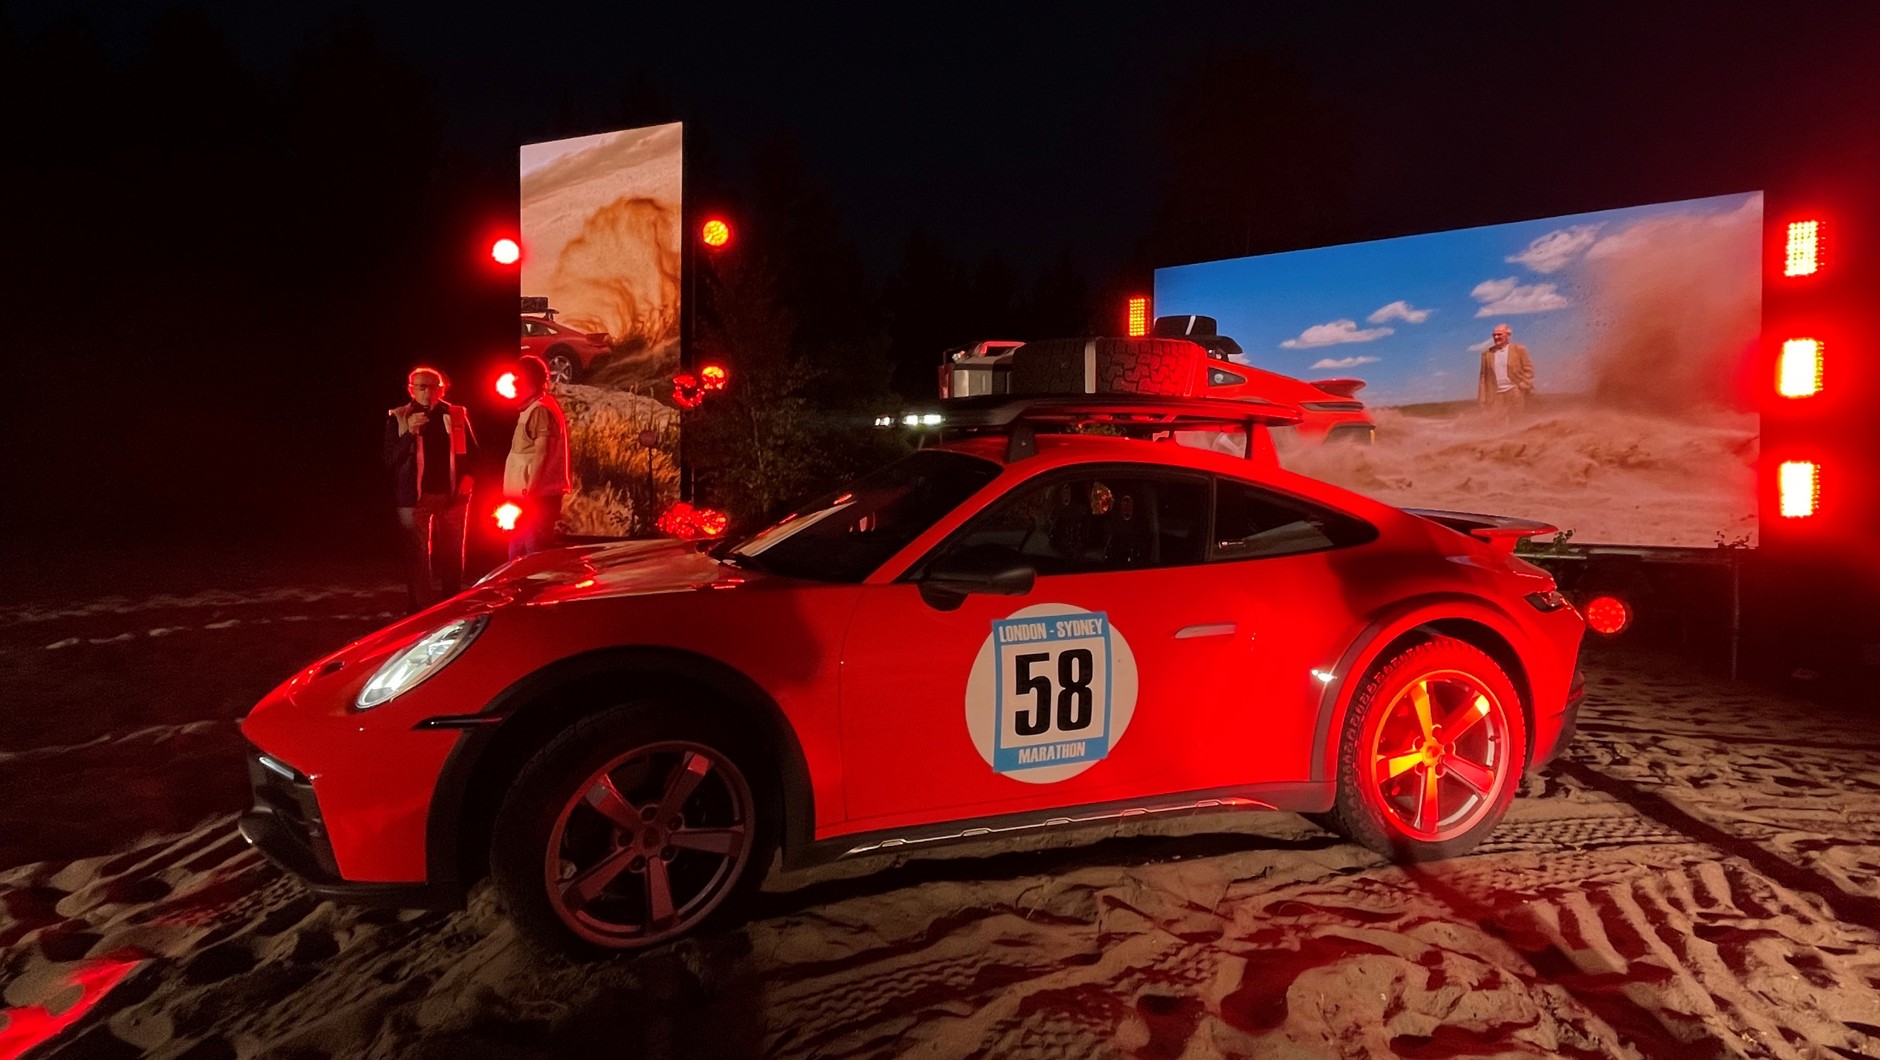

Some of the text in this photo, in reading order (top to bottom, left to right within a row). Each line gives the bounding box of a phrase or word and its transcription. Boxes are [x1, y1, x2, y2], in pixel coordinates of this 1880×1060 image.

[999, 622, 1046, 643] LONDON
[1056, 618, 1103, 638] SYDNEY
[1015, 649, 1093, 736] 58
[1018, 741, 1086, 765] MARATHON
